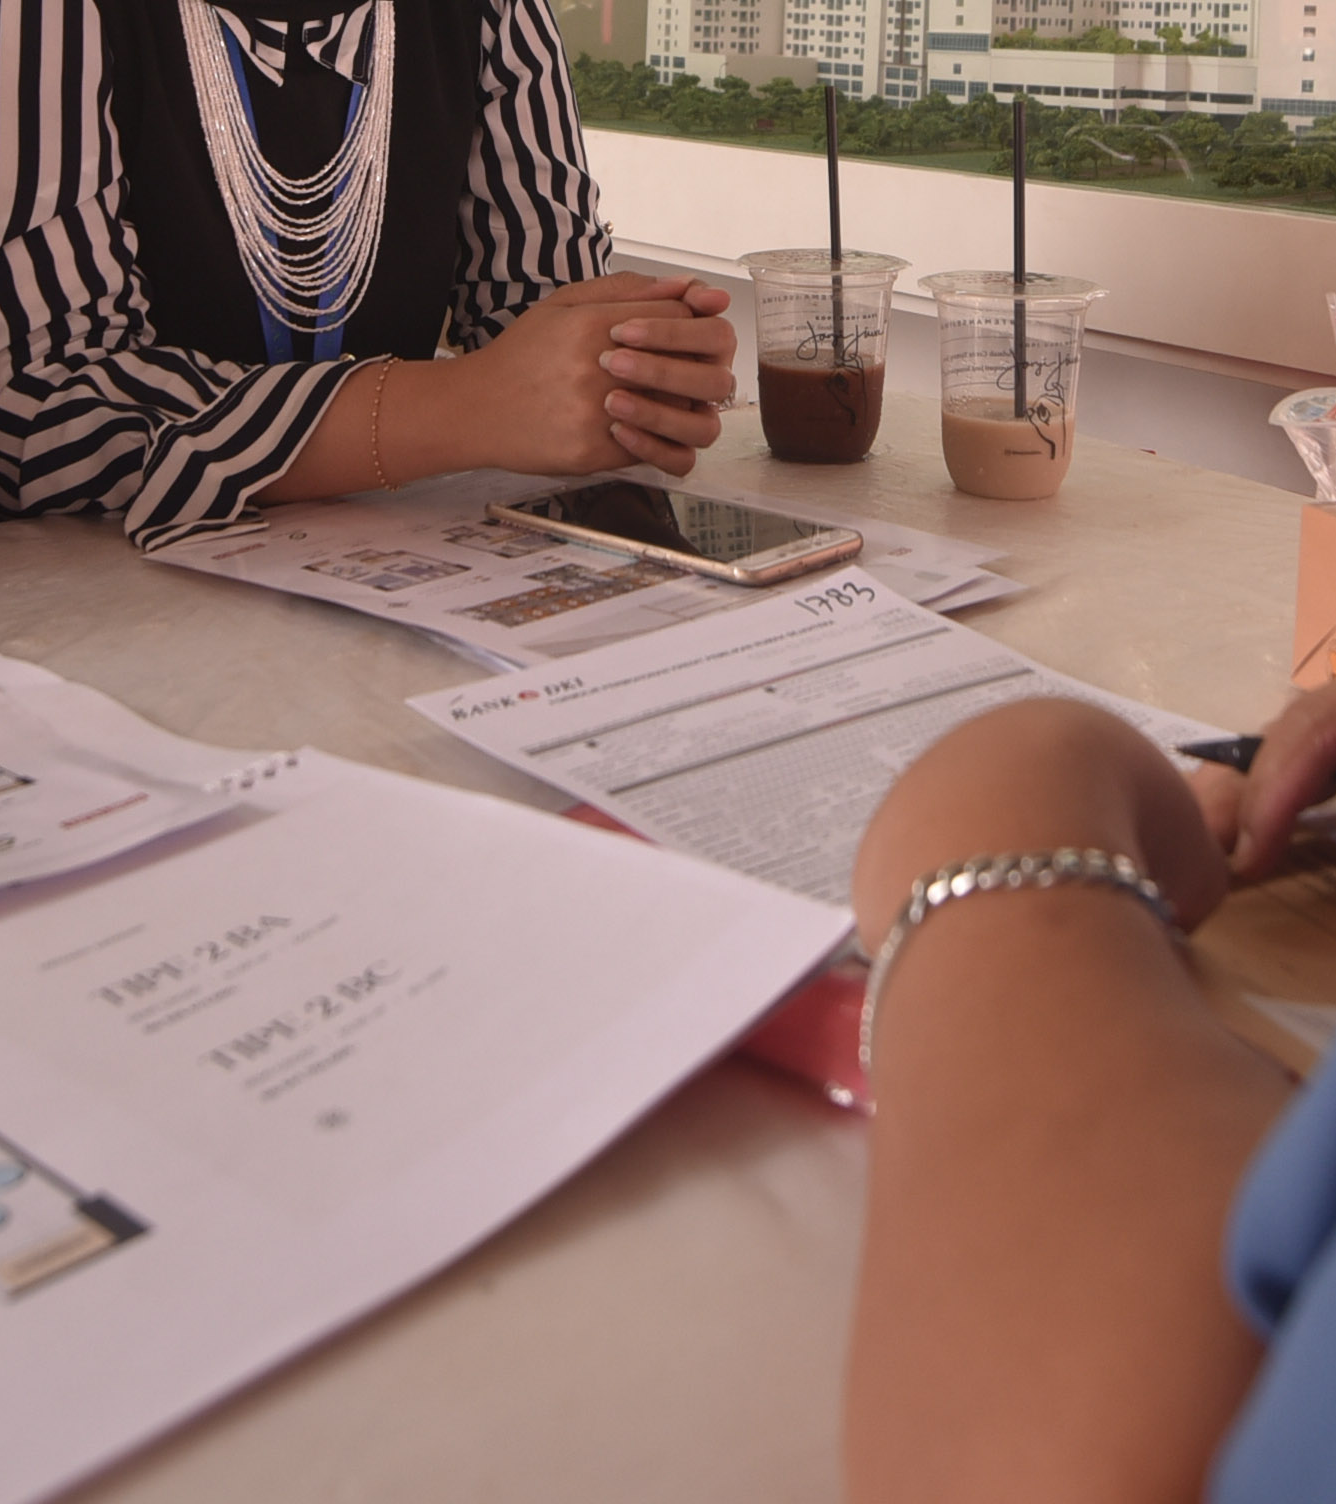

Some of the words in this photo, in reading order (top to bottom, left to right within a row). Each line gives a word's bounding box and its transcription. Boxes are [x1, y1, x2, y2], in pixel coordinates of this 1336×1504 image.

[794, 581, 875, 616] 1783
[450, 695, 516, 721] BANK
[544, 676, 584, 696] DKI
